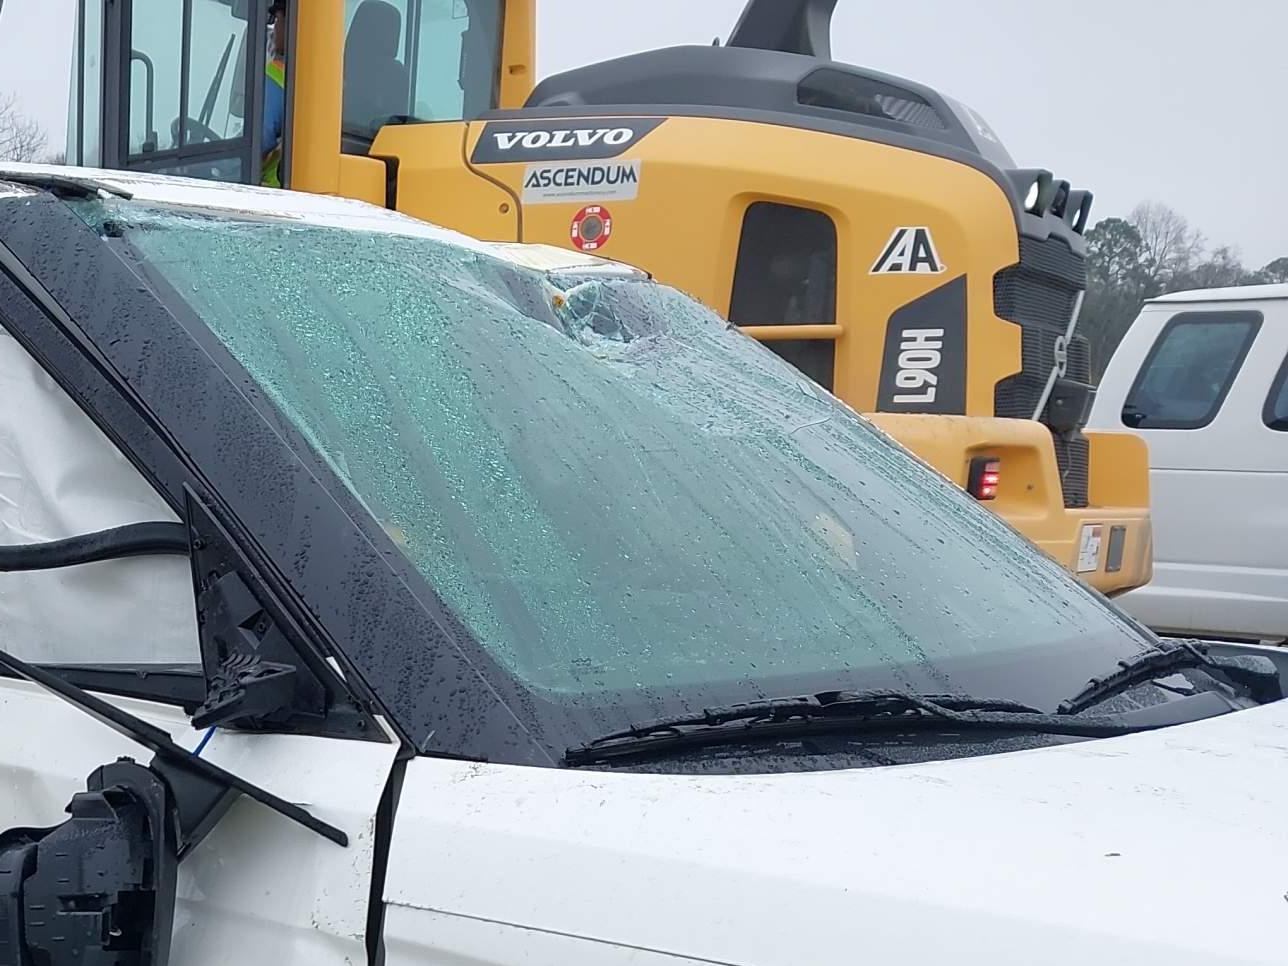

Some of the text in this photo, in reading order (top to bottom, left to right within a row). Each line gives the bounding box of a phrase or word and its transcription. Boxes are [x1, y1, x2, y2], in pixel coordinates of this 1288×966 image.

[493, 127, 634, 149] VOLVO
[524, 165, 638, 188] ASCENDUM
[893, 328, 945, 403] L90H
